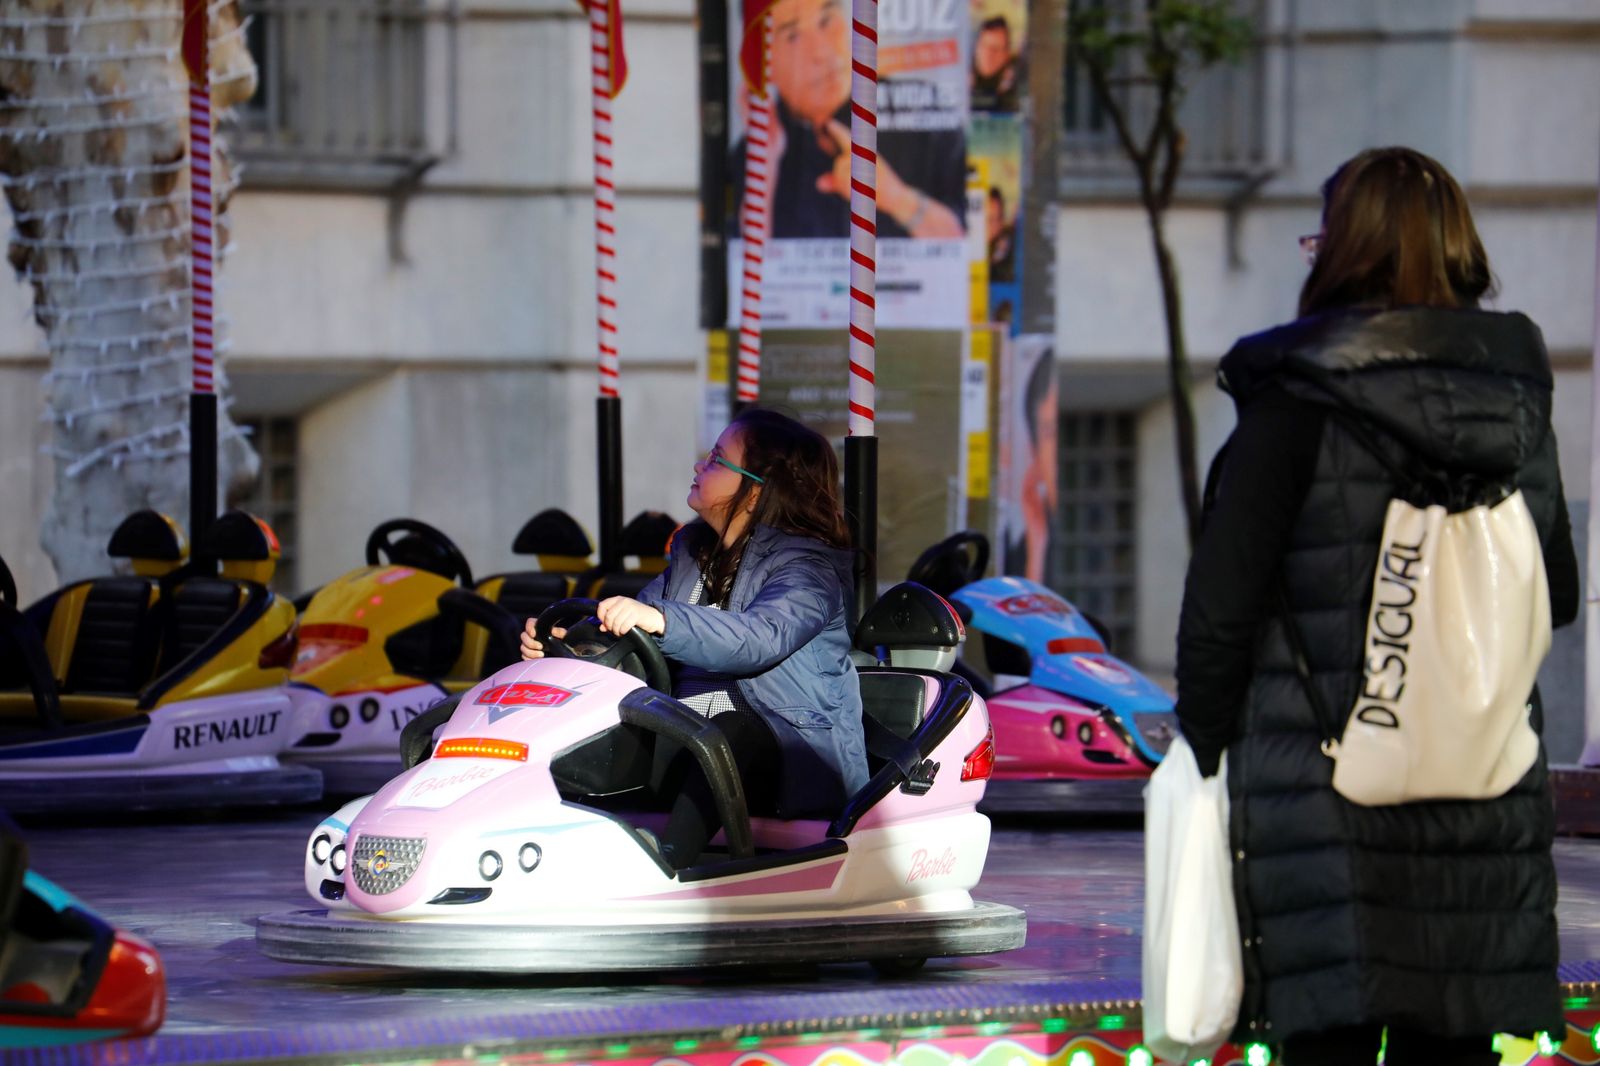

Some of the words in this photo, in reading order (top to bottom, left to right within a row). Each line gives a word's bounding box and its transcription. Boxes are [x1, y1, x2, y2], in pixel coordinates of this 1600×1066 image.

[1357, 531, 1427, 729] DESIGUAL
[173, 711, 282, 750] RENAULT
[411, 765, 496, 798] Barbie
[905, 847, 956, 885] Barbie
